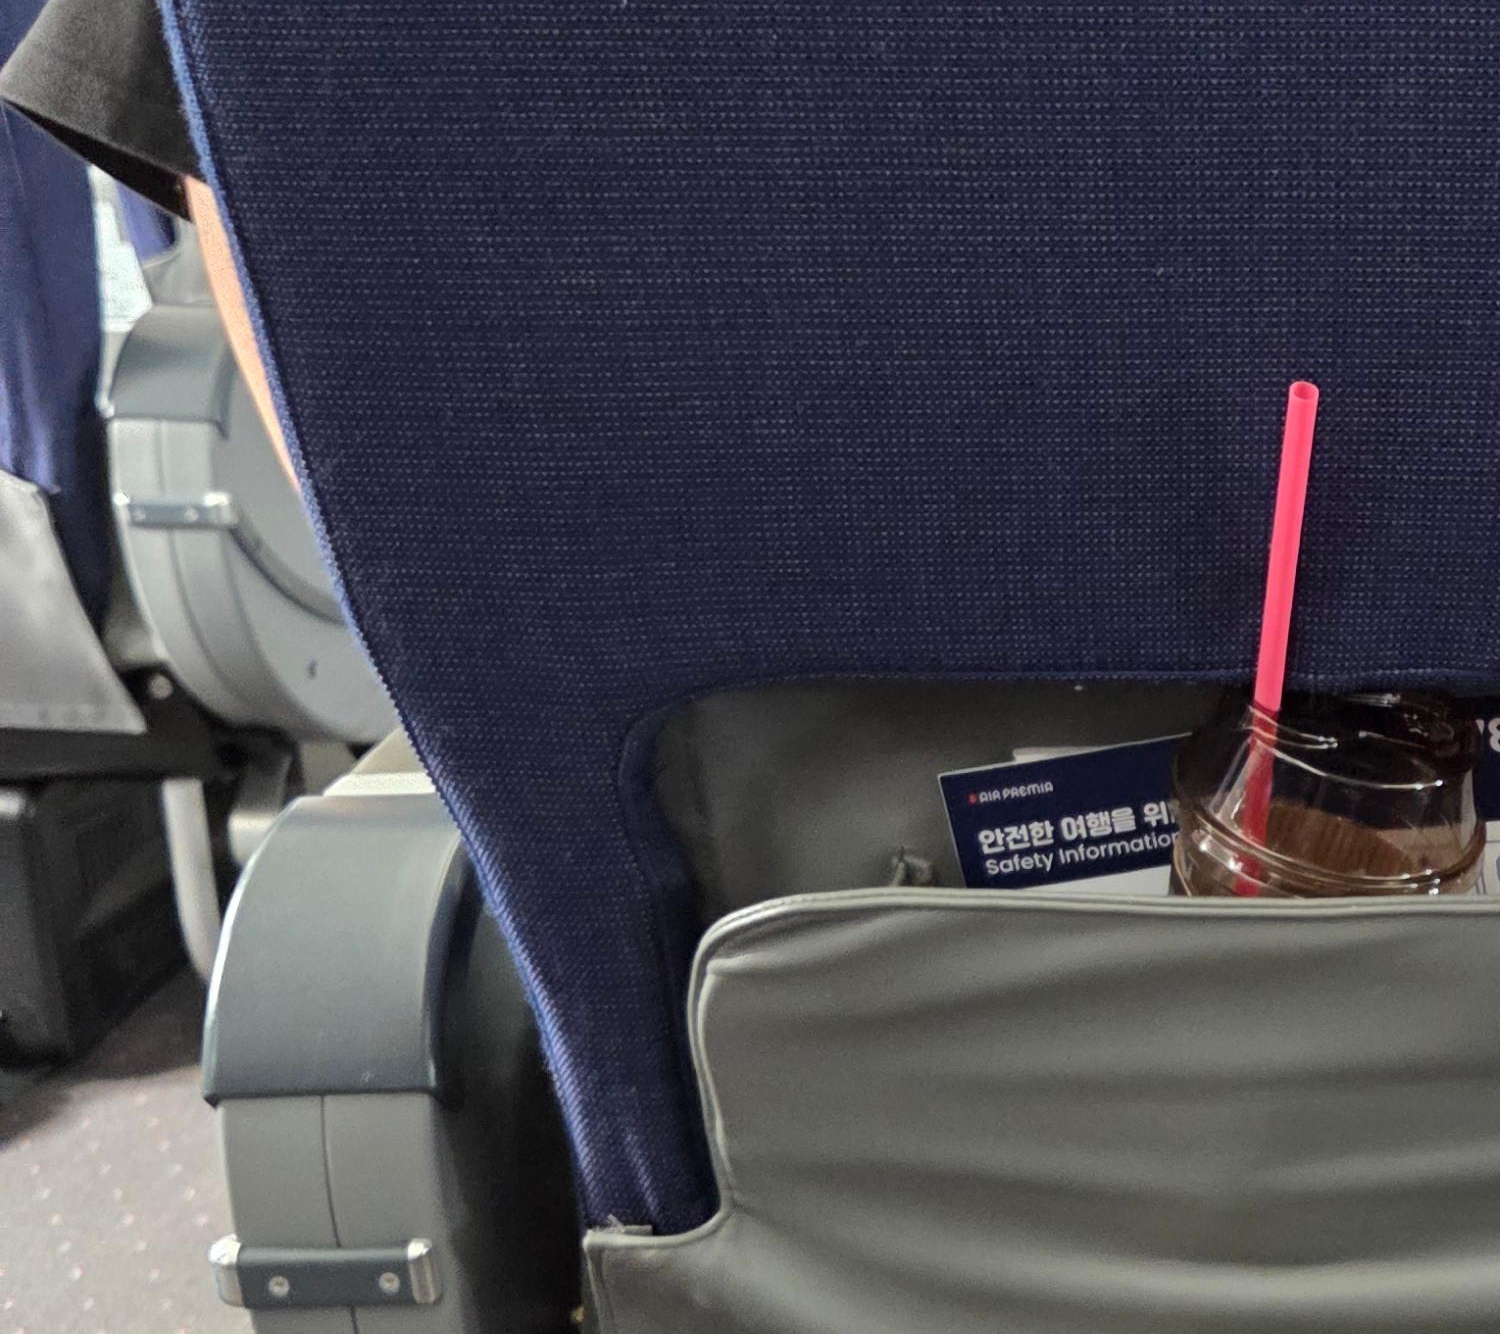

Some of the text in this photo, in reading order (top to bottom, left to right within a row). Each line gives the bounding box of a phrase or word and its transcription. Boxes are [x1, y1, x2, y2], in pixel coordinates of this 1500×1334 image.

[979, 781, 1054, 803] AIR PREMIA
[978, 800, 1176, 855] 안전한 여행을 위
[985, 852, 1054, 876] Safety
